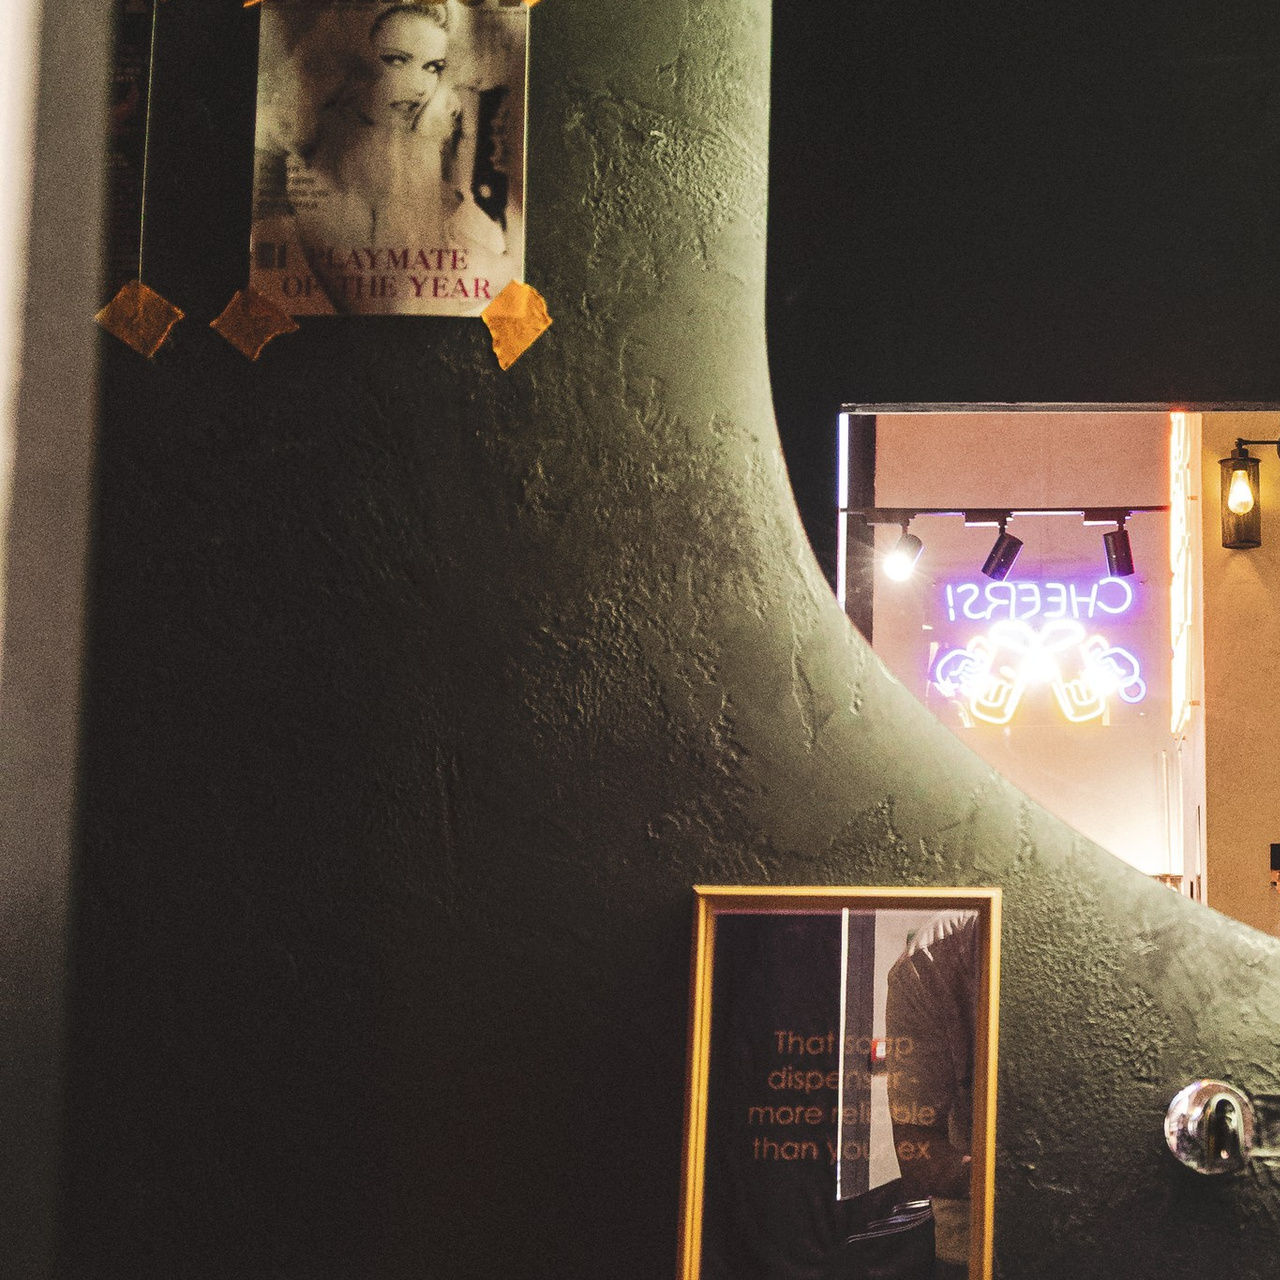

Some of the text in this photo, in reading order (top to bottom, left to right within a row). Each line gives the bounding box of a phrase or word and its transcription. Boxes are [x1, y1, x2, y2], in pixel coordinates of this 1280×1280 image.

[306, 246, 468, 270] PLAYMATE
[342, 276, 397, 298] THE
[409, 276, 491, 300] YEAR
[774, 1030, 834, 1055] That
[749, 1101, 936, 1126] more relible
[753, 1136, 818, 1161] than
[897, 1141, 931, 1161] ex
